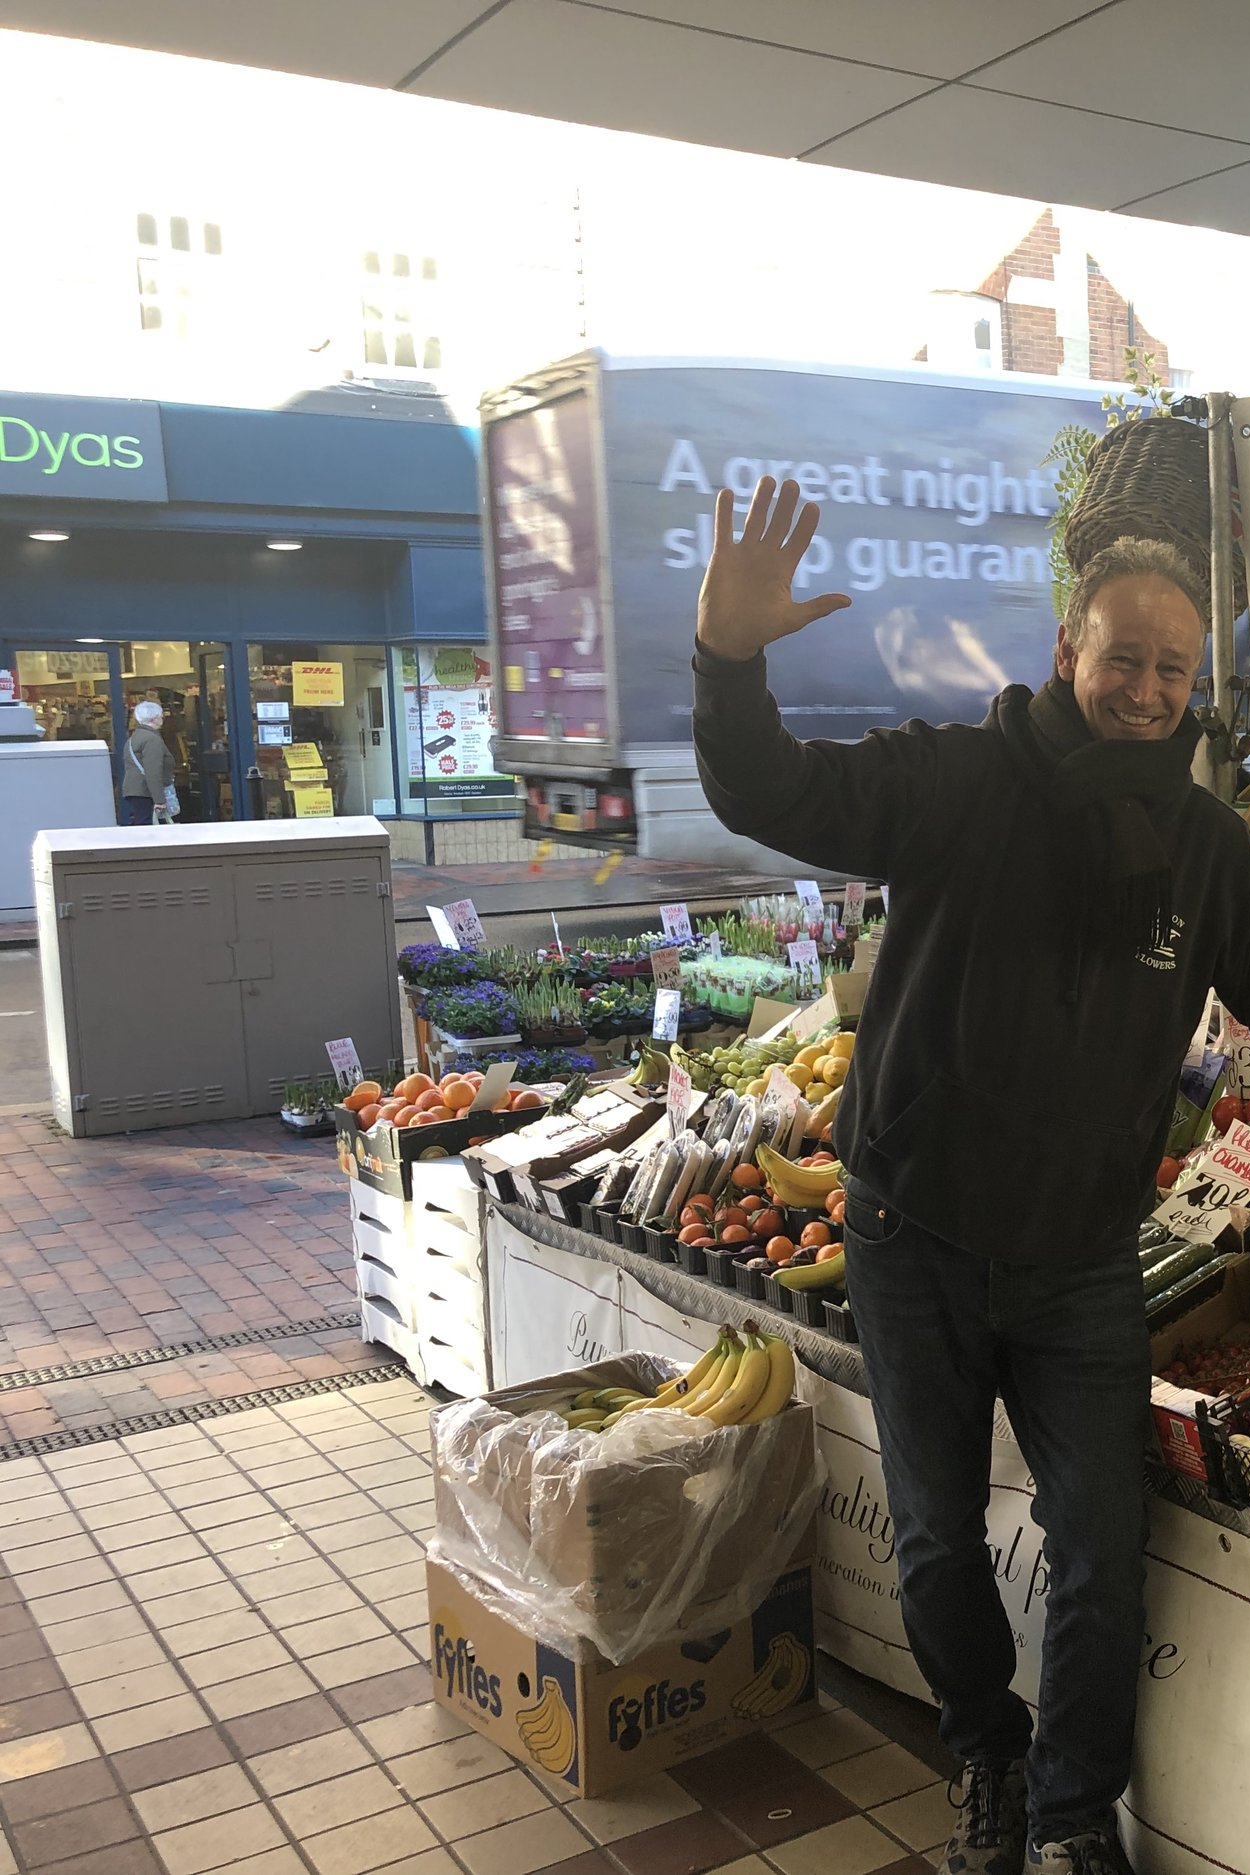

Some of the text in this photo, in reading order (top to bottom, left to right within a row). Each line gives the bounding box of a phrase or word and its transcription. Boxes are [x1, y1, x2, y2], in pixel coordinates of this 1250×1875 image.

[0, 415, 144, 475] Dyas
[659, 439, 711, 493] A
[722, 456, 890, 514] great
[846, 534, 1054, 592] guaran
[301, 667, 335, 675] DHL
